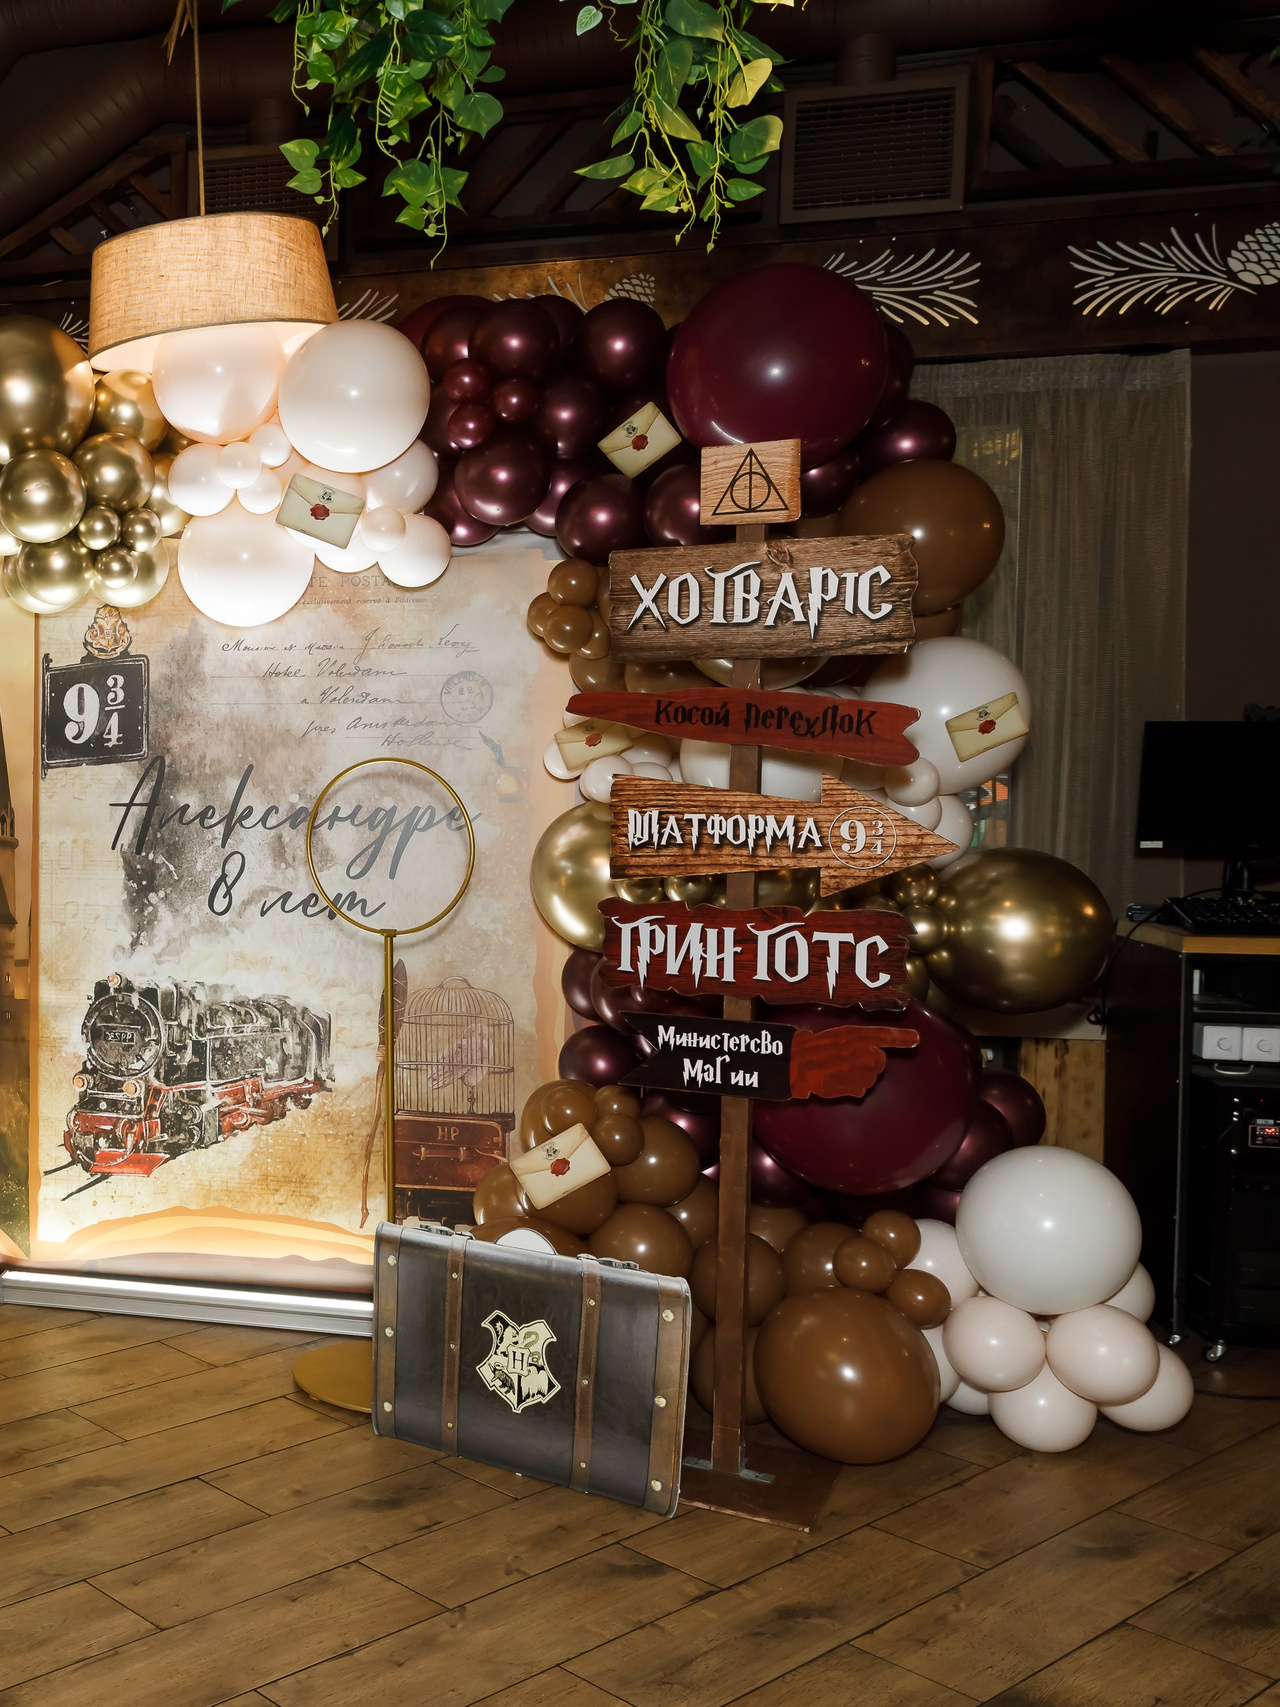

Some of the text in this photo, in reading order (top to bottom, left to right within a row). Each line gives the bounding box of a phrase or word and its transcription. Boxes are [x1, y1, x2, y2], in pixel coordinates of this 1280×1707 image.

[626, 561, 894, 640] ХОГВАРТС
[654, 699, 731, 728] Косой
[108, 755, 482, 880] Александре
[207, 851, 387, 920] 8 лет
[436, 1125, 460, 1141] HP
[511, 1351, 526, 1373] H
